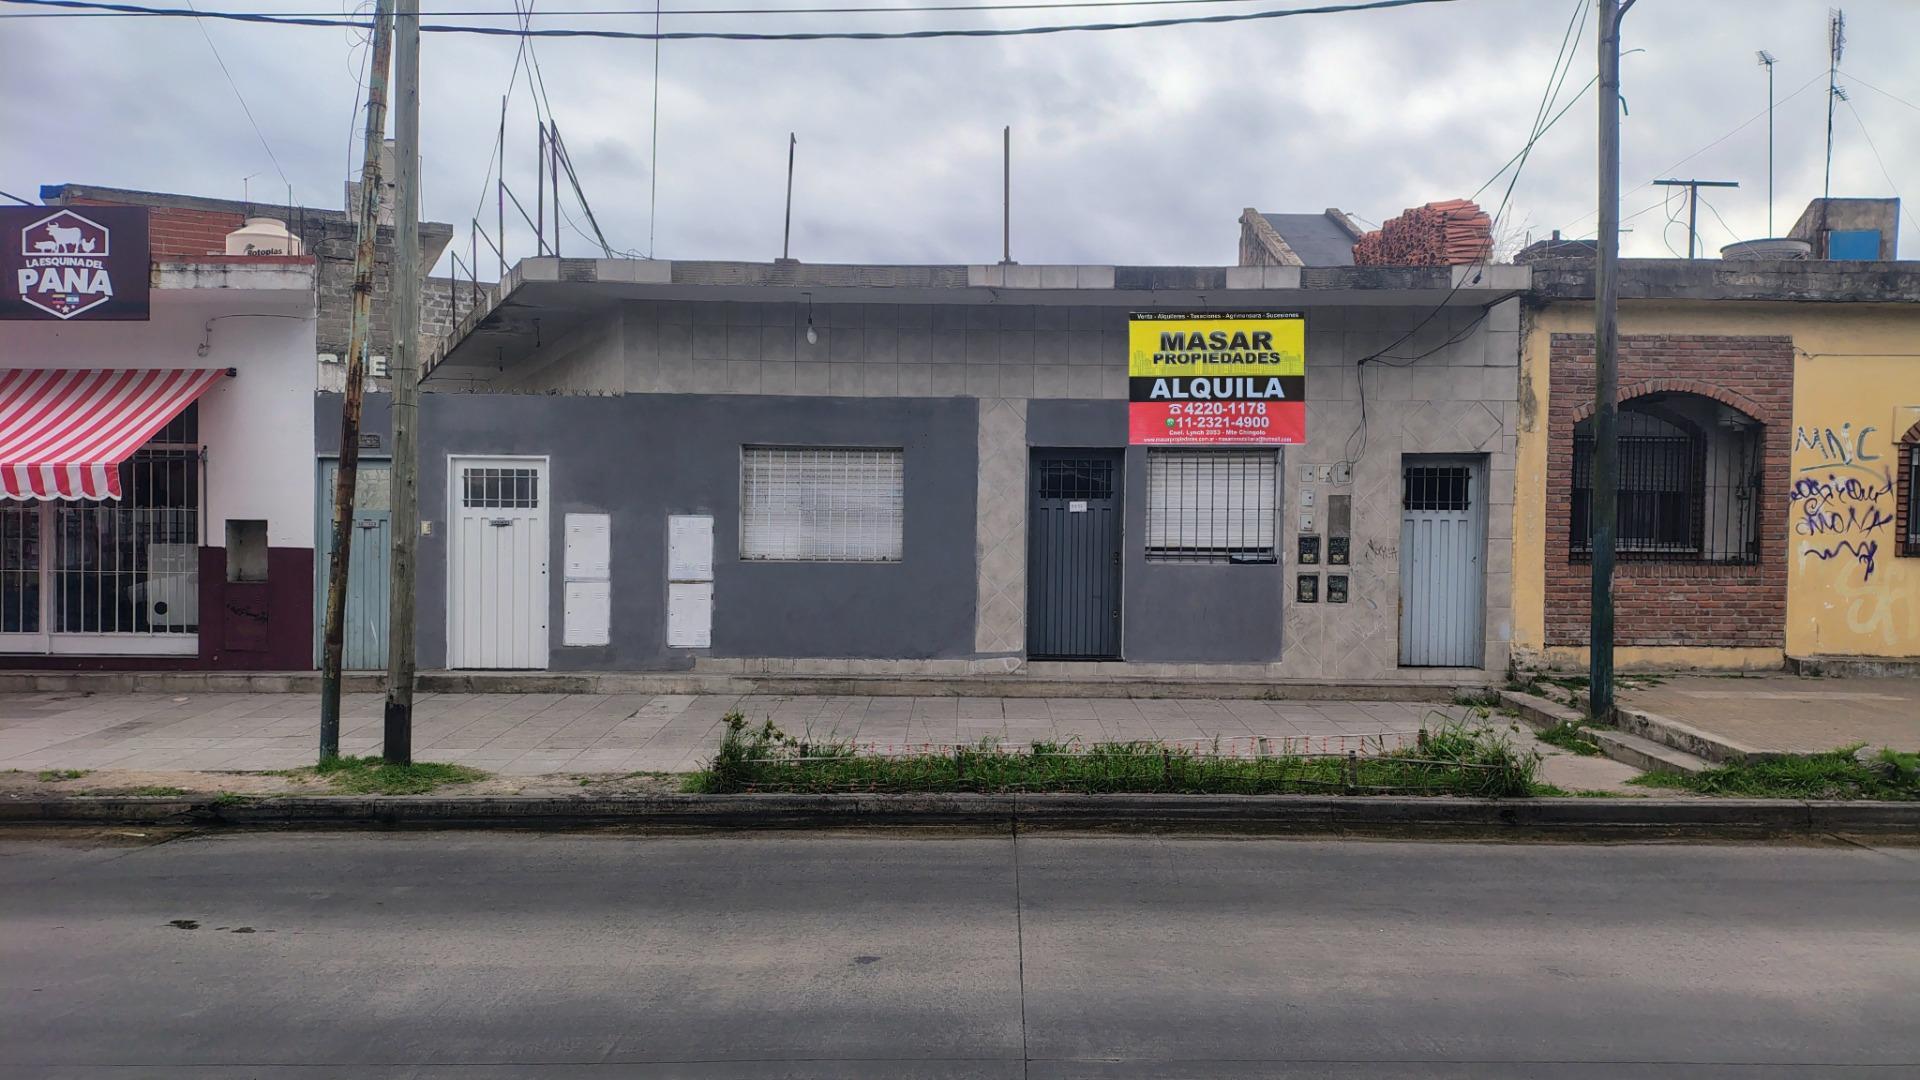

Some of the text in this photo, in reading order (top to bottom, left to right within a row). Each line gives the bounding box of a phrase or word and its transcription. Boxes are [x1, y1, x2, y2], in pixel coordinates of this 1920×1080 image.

[25, 257, 104, 269] LA ESQUINA DEL
[17, 267, 113, 296] PANA
[1160, 331, 1273, 351] MASAR
[1153, 352, 1281, 365] PROPIEDADES
[1149, 377, 1286, 400] ALQUILA
[1184, 402, 1266, 415] 4220-1178
[1176, 416, 1270, 428] 11-2321-4900
[1186, 429, 1205, 437] Lynch
